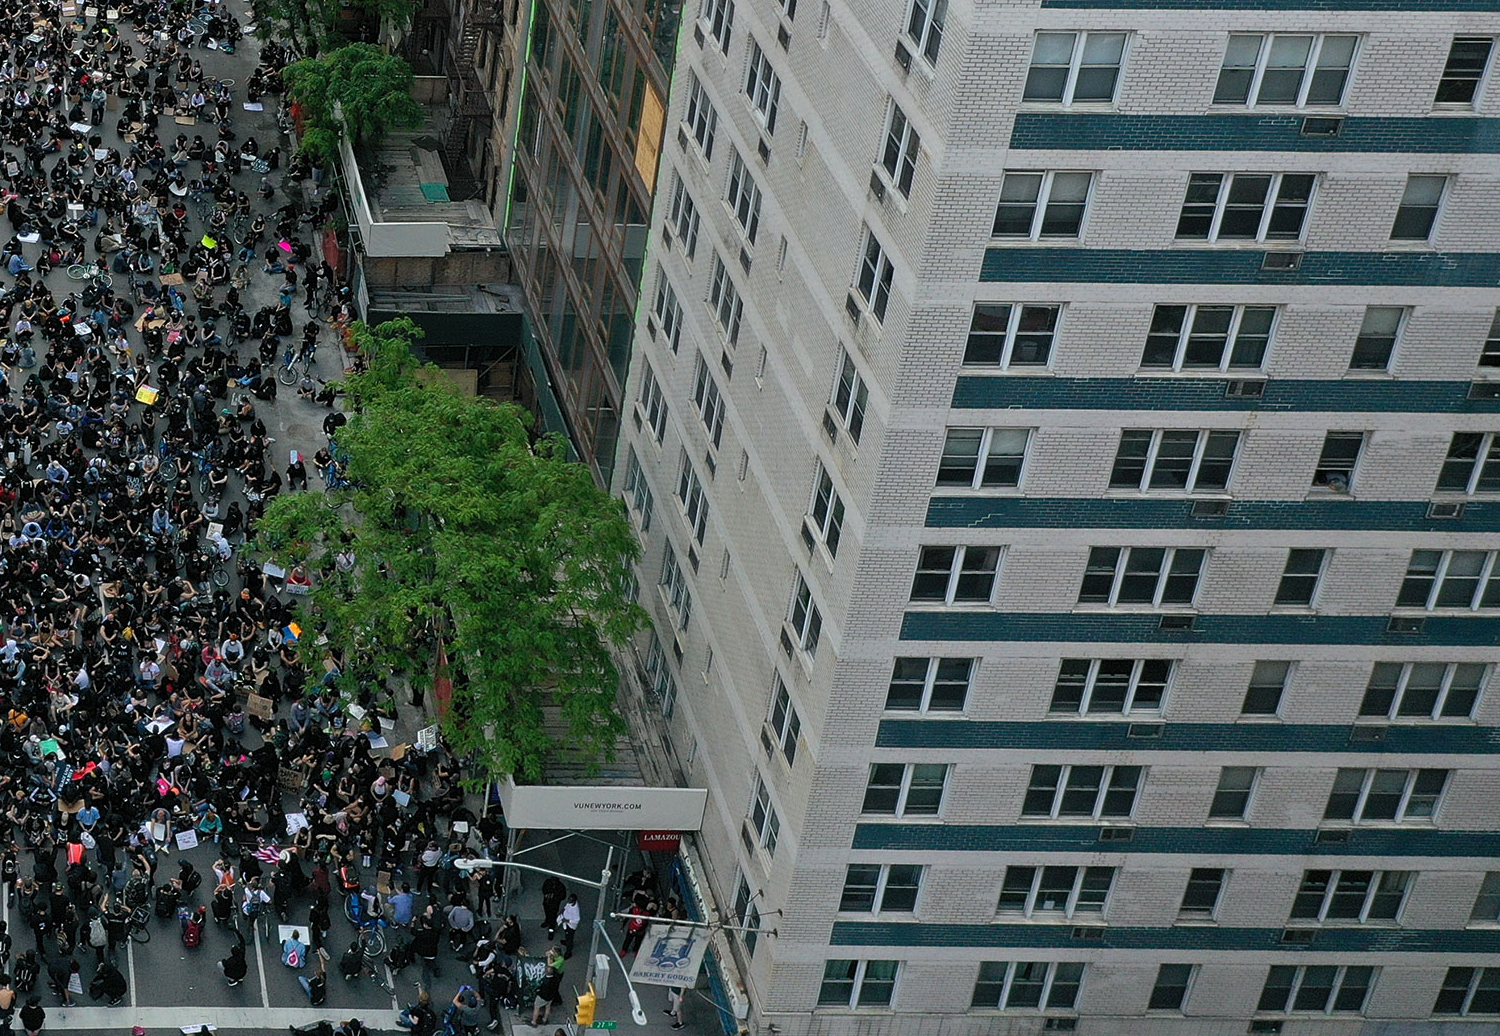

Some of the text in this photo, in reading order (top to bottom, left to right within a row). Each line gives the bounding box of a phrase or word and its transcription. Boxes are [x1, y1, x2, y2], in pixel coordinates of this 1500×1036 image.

[573, 802, 642, 810] VUNEWYORK.COM
[633, 971, 666, 979] BAKERY
[667, 973, 694, 982] GOODS
